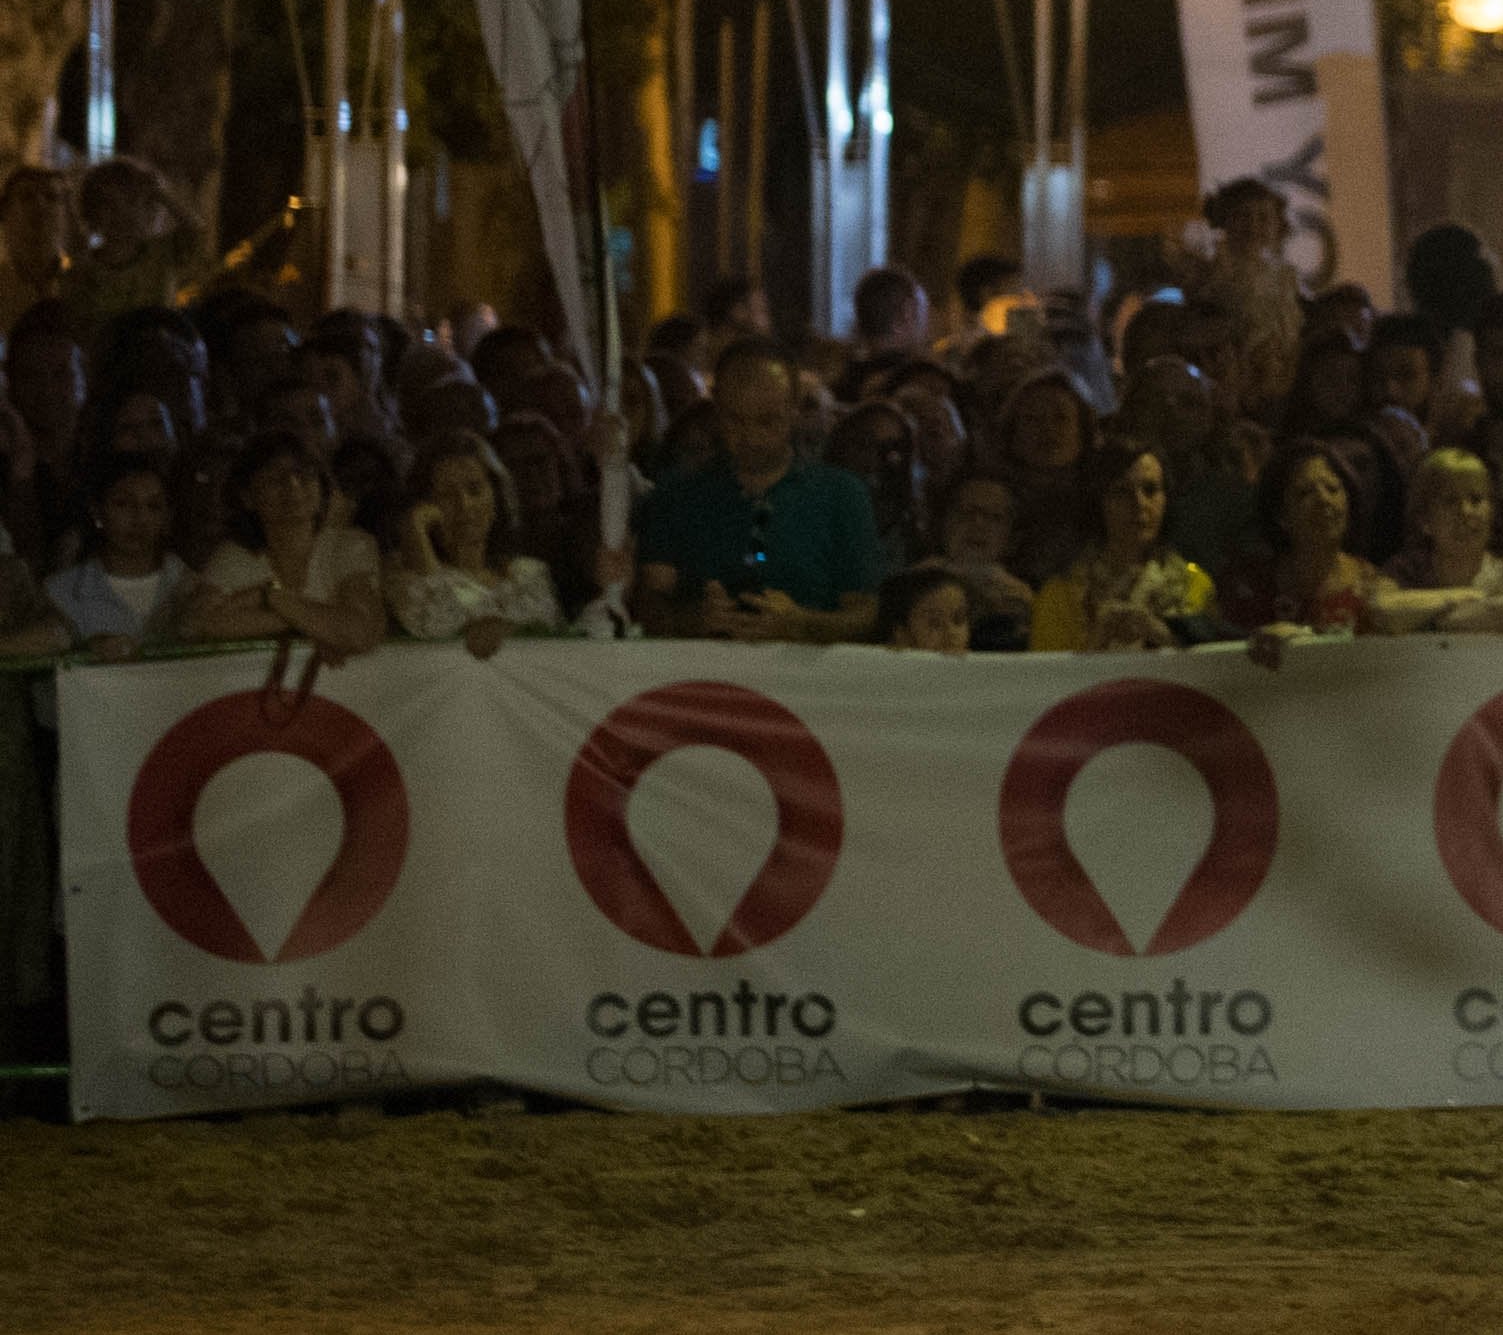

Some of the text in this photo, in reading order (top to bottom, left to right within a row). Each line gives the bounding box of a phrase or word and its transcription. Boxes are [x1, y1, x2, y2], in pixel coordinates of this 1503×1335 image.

[149, 986, 406, 1046] centro
[586, 978, 837, 1038] centro
[1017, 976, 1273, 1036] centro
